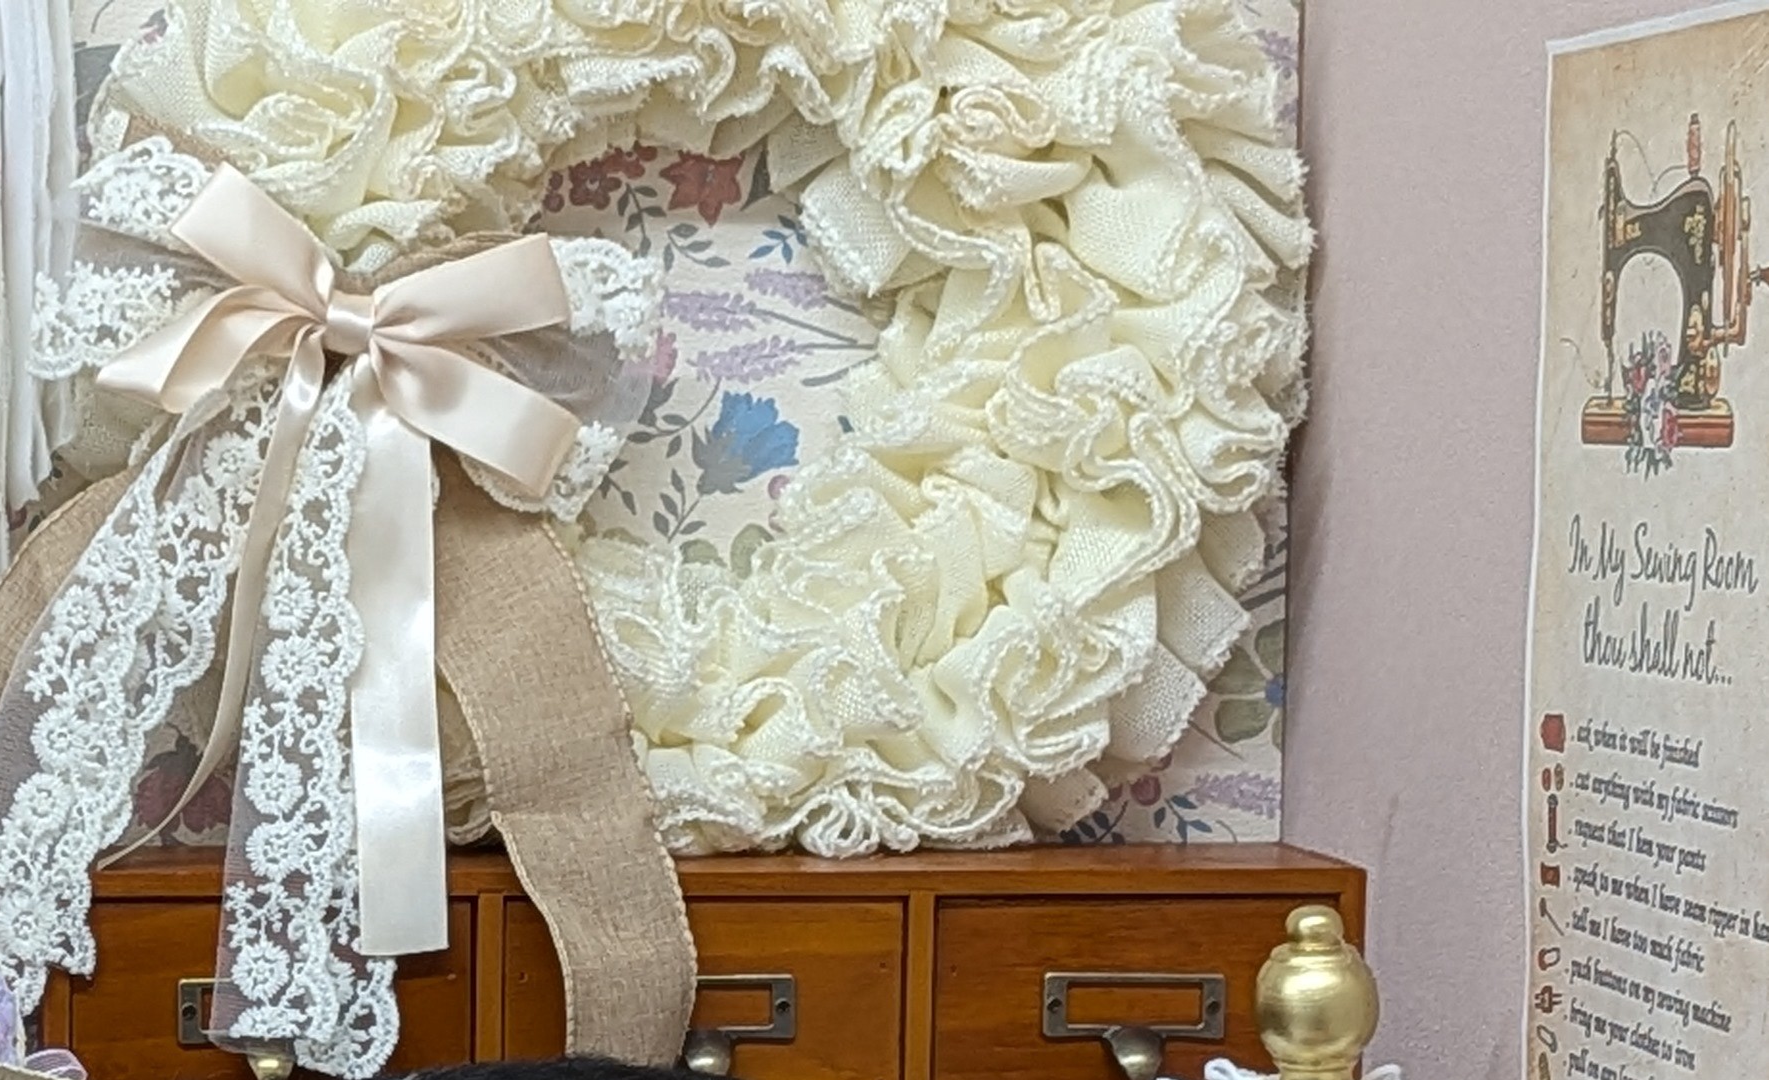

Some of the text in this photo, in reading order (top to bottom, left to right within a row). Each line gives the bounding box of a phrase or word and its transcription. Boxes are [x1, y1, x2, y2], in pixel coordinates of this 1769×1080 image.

[1568, 514, 1759, 611] In My Sewing Room
[1584, 596, 1625, 669] thou
